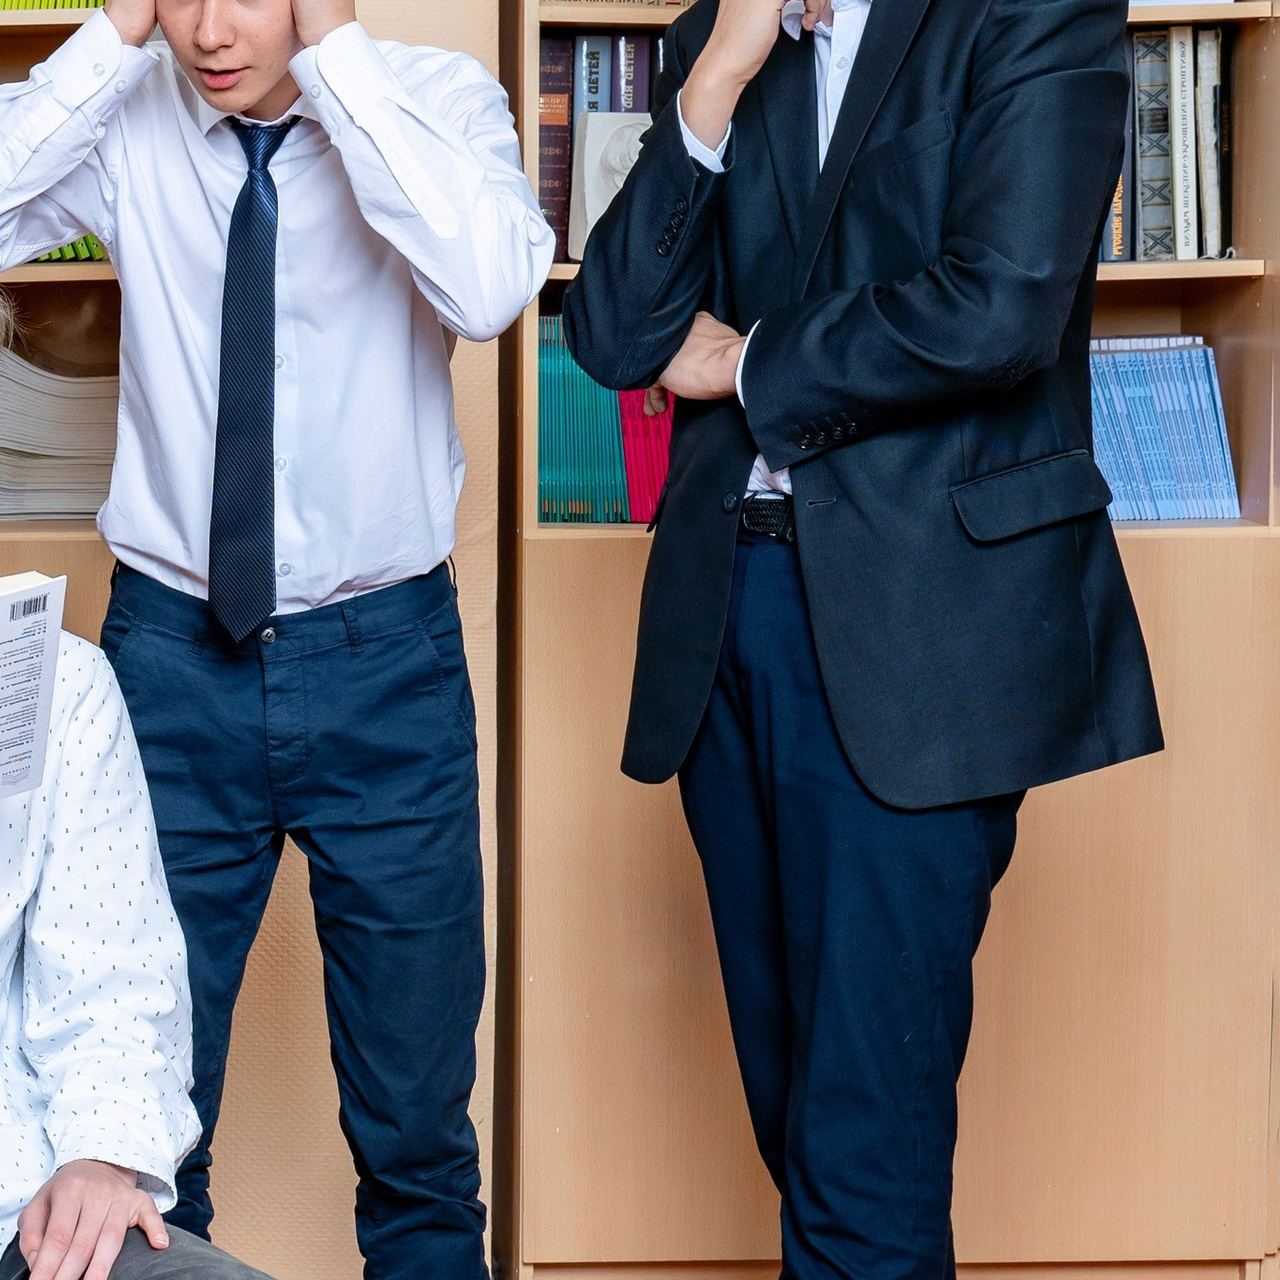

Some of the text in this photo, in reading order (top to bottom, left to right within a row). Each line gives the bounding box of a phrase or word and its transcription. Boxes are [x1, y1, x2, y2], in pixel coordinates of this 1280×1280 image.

[587, 50, 600, 94] ДЕТЕЙ
[624, 84, 633, 108] ДЛЯ
[1112, 216, 1125, 255] РУССКИЕ
